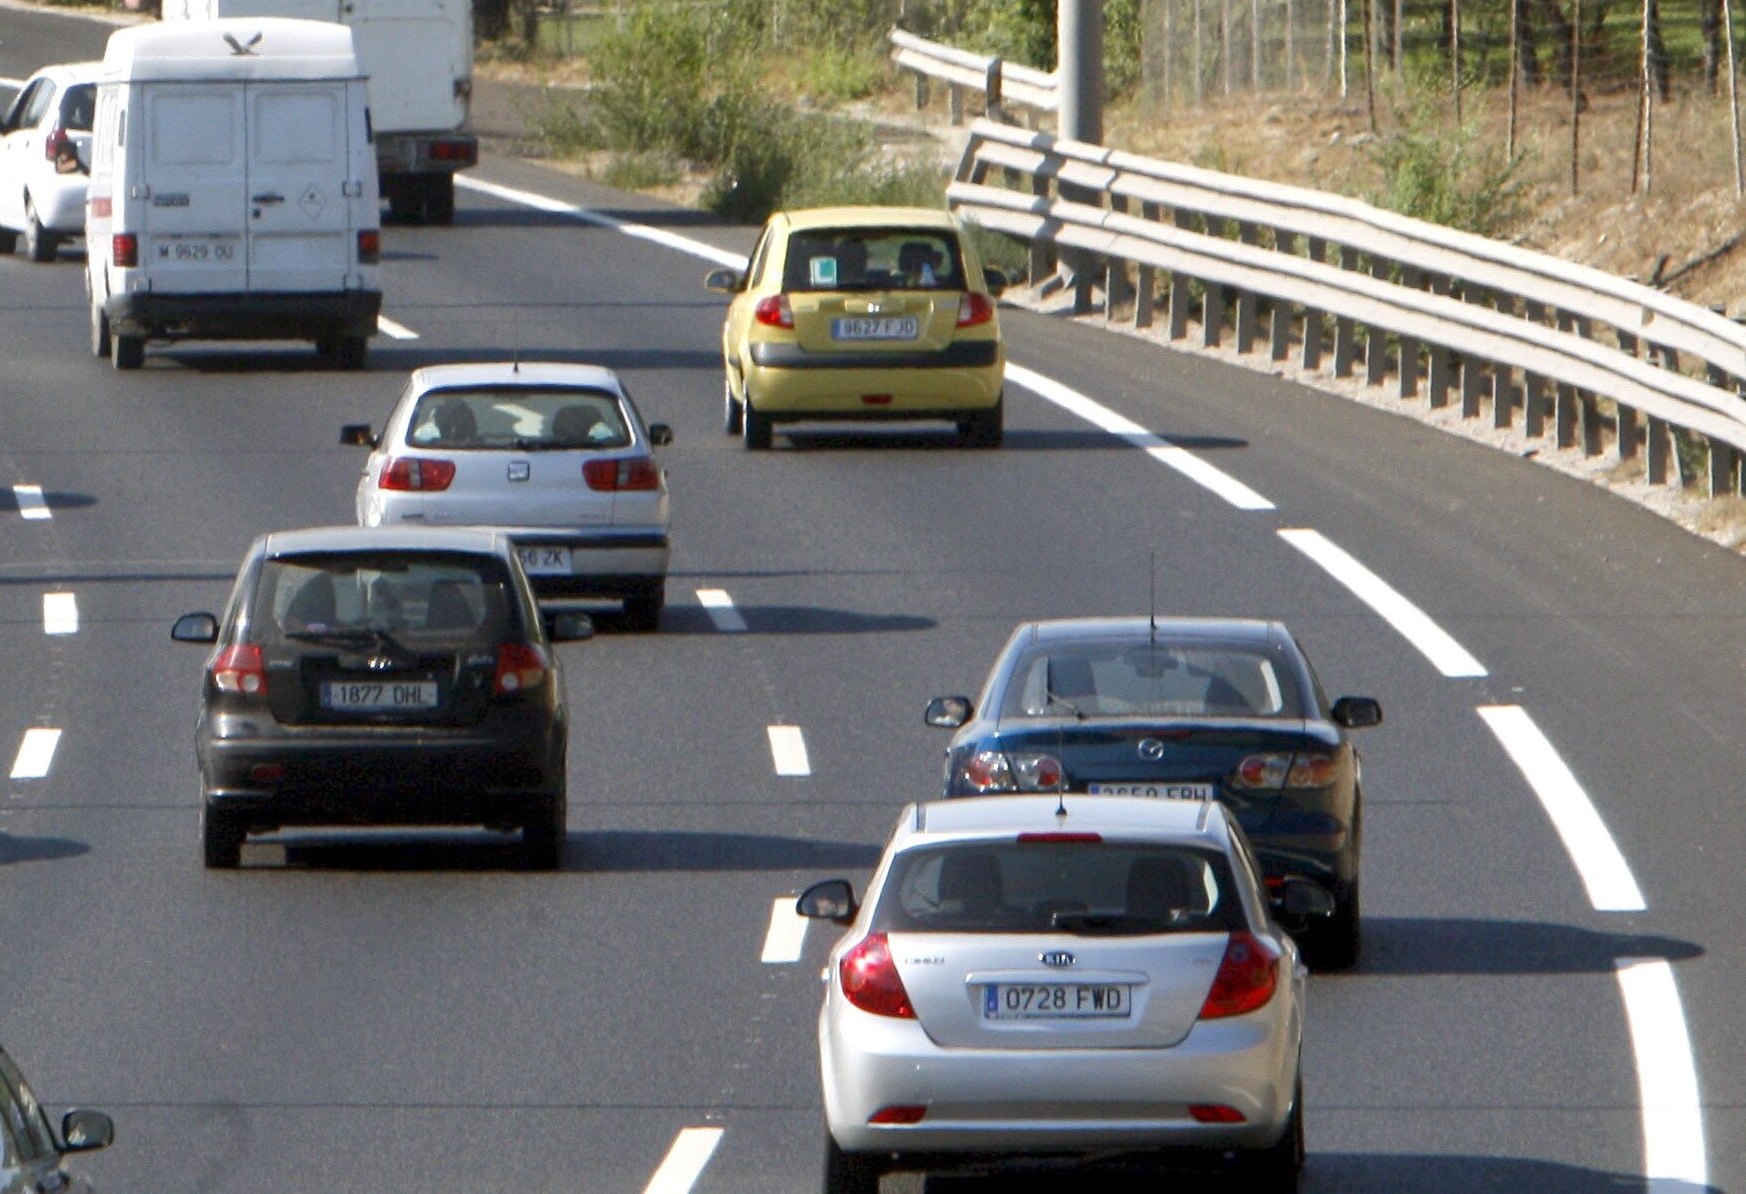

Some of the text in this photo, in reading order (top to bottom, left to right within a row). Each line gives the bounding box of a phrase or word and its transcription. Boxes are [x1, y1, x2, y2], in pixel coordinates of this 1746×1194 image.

[339, 685, 424, 704] 1877 DHL
[1005, 986, 1122, 1012] 0728 FWD
